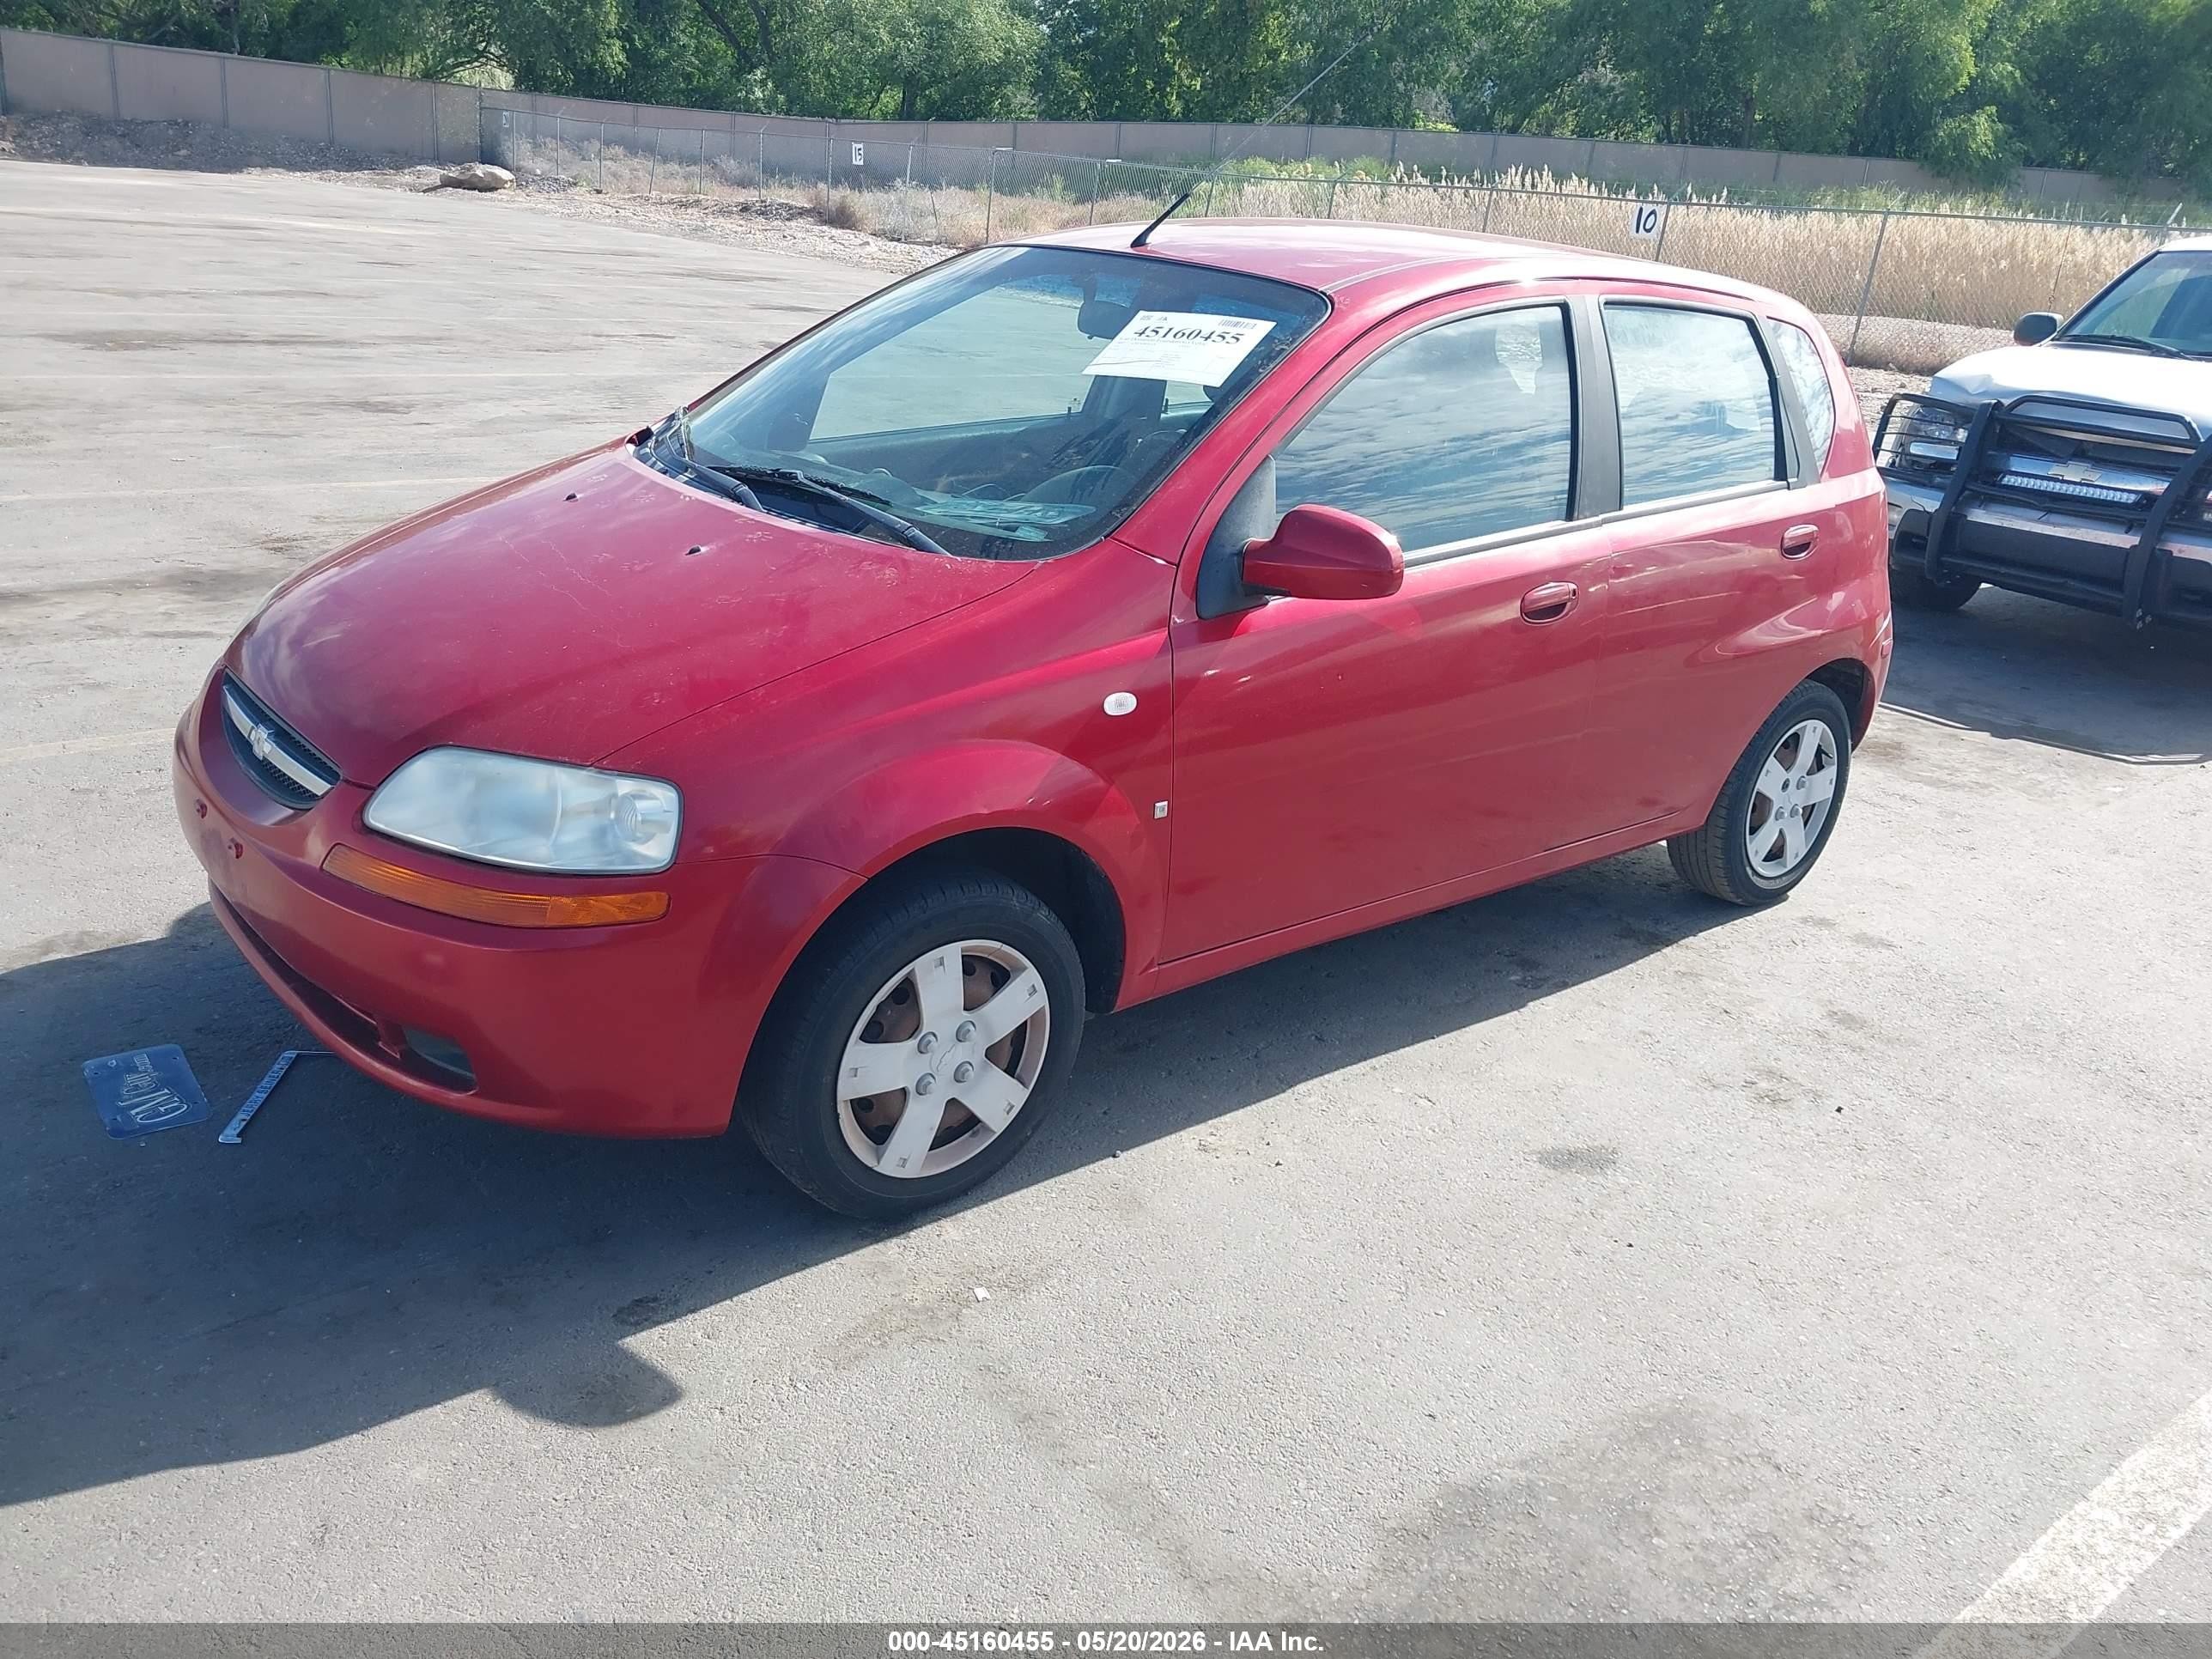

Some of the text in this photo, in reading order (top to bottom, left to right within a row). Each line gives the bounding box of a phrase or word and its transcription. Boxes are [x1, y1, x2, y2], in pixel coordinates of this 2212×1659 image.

[854, 146, 862, 162] 15
[1636, 206, 1657, 234] 10
[1134, 325, 1244, 344] 45160455
